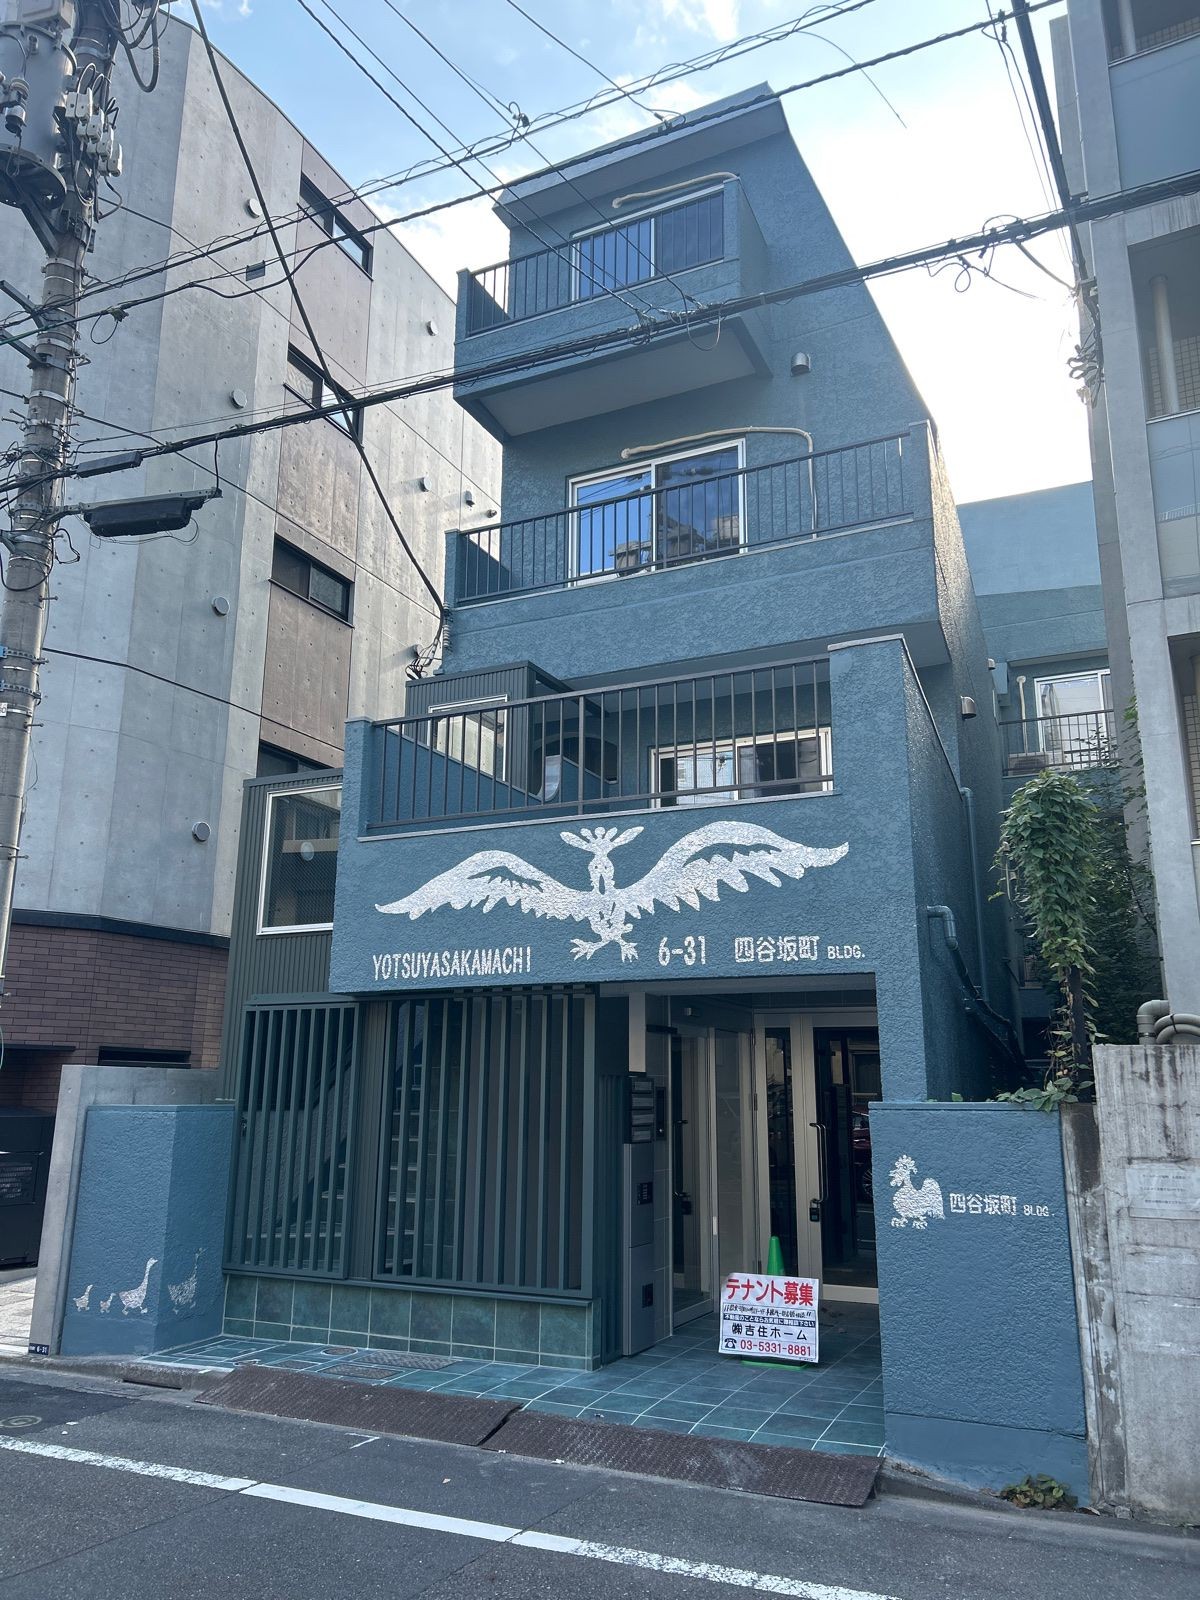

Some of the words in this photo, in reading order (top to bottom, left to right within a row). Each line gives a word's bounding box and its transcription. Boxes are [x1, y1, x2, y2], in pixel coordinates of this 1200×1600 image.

[658, 935, 706, 966] 6-31
[735, 935, 820, 963] 四谷坂町
[827, 945, 865, 959] BLDG.
[372, 946, 532, 981] YOTSUYASAKAMACHI
[949, 1192, 1017, 1216] 四谷坂町
[726, 1278, 813, 1306] テナント募集
[740, 1339, 811, 1357] 03-5331-8881
